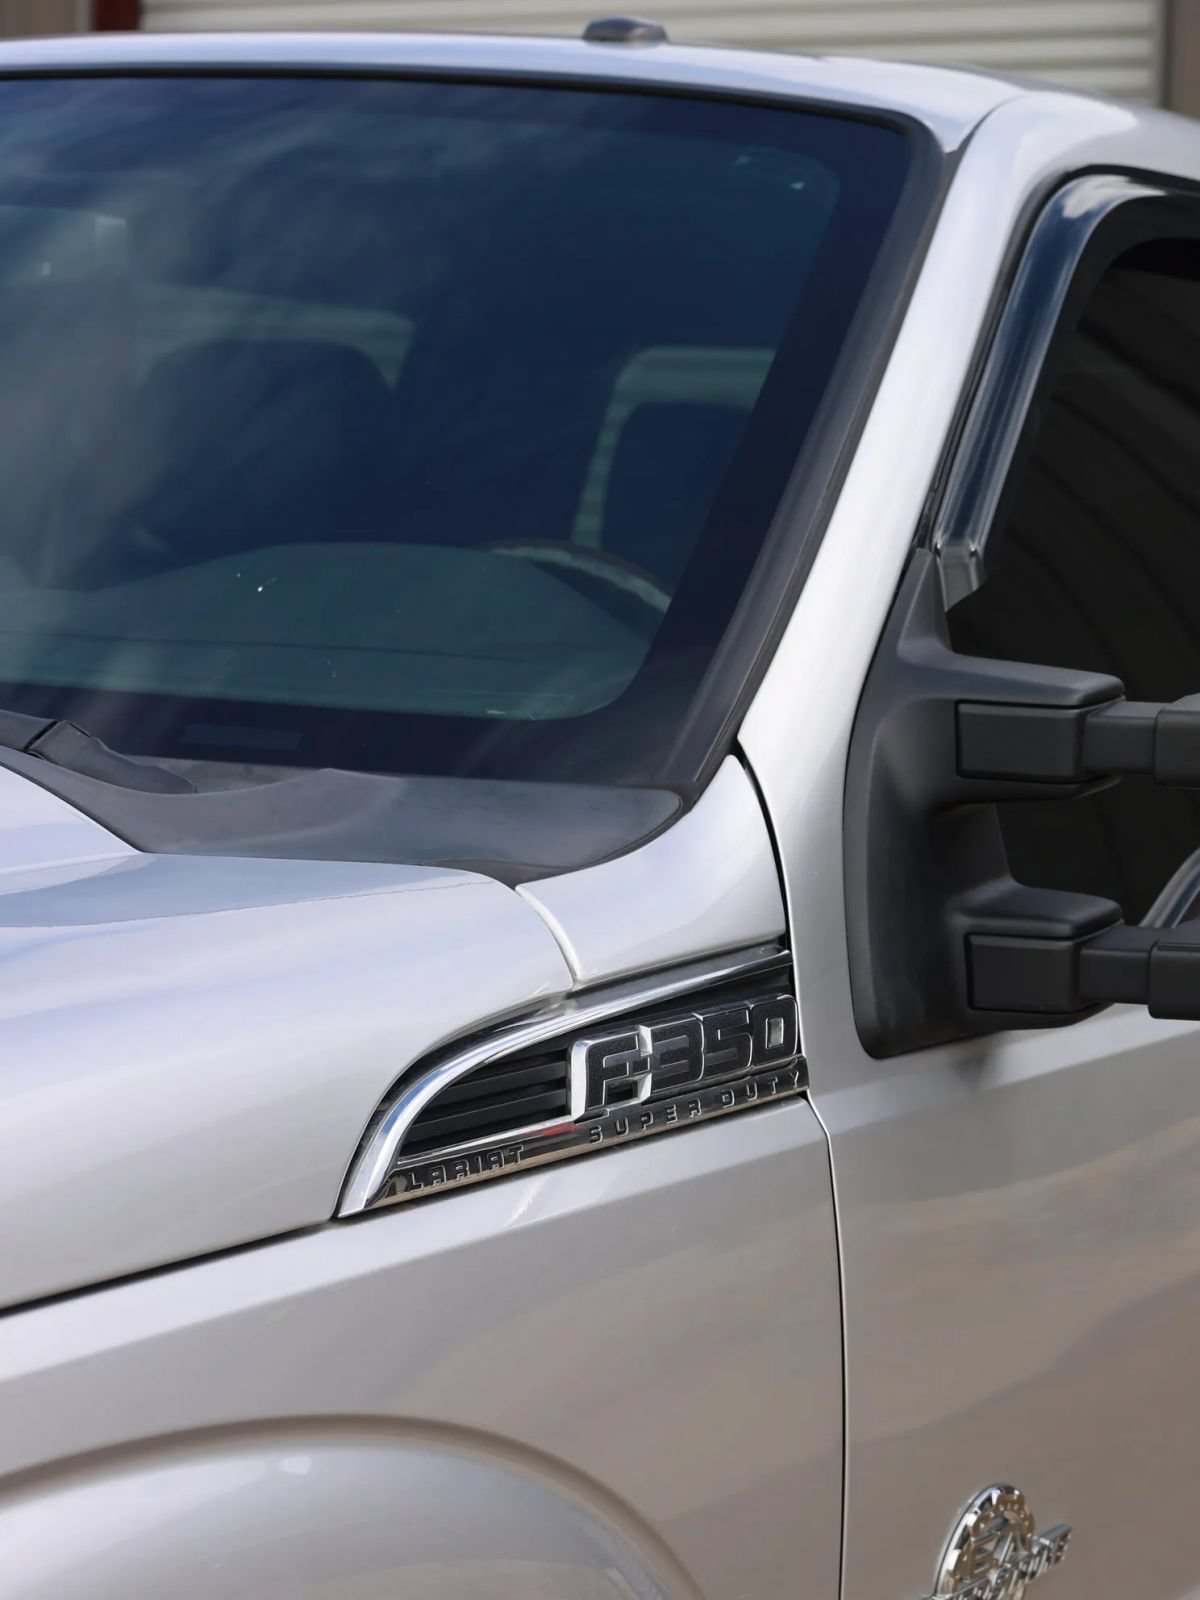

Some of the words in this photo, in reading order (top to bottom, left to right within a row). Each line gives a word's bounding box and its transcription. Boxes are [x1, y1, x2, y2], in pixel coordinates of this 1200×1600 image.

[588, 1098, 702, 1144] SUPER
[721, 1070, 800, 1109] DUTY
[408, 1145, 524, 1193] LARIAT
